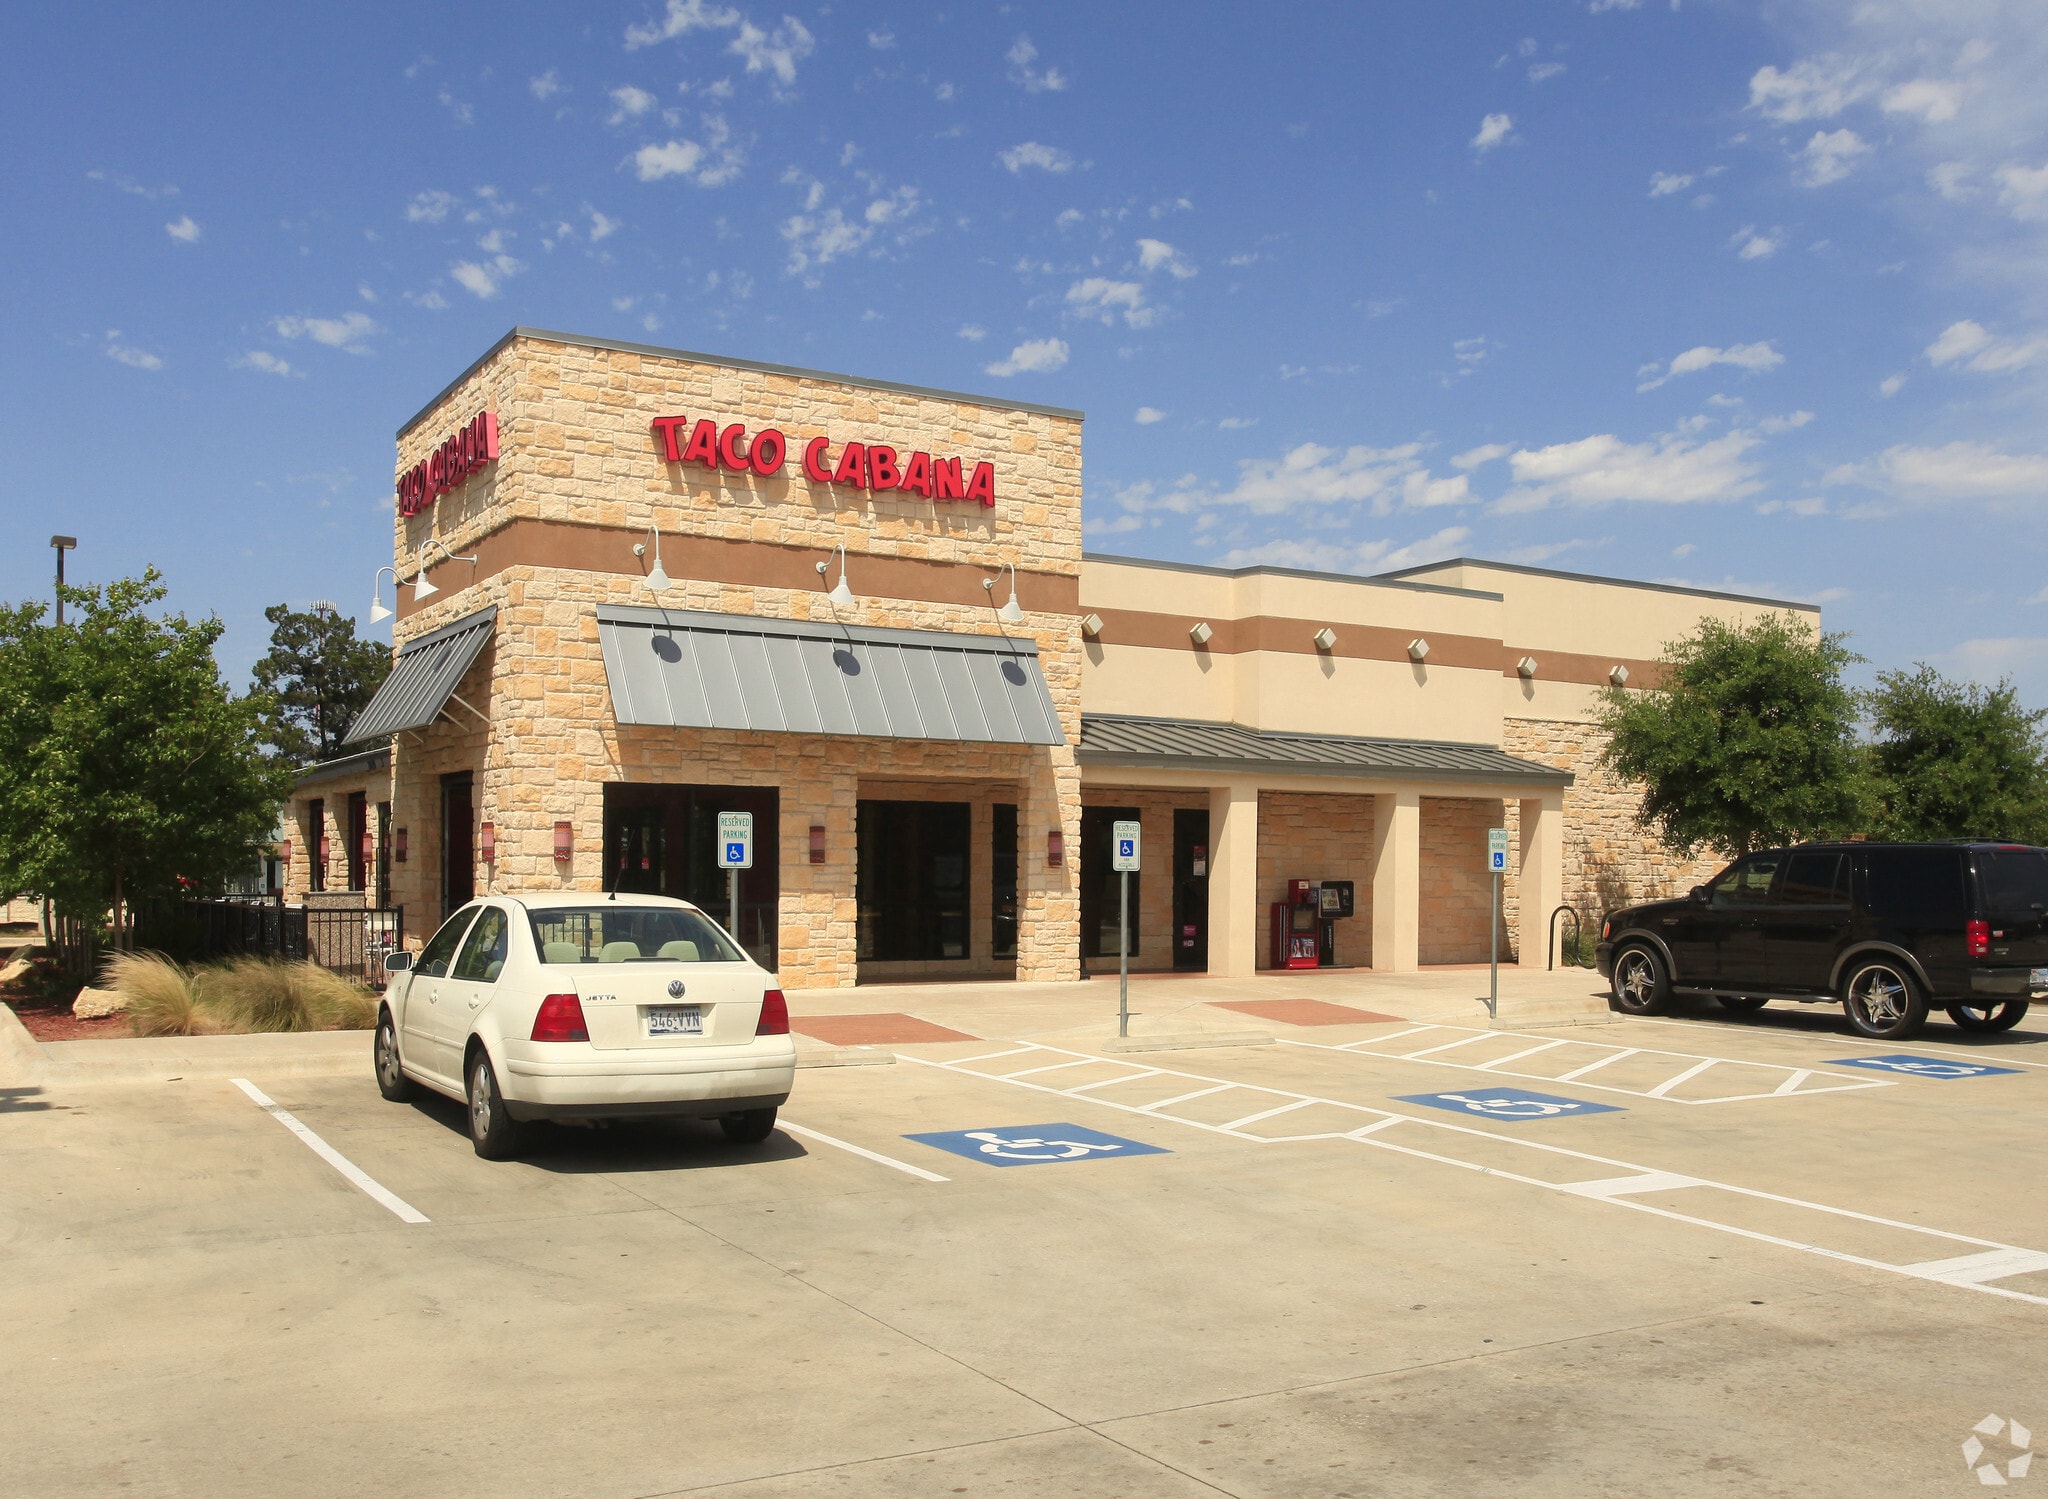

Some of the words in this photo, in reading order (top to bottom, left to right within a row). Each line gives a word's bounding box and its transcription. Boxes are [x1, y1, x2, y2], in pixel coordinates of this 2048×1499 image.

[652, 415, 786, 476] TACO
[801, 436, 995, 508] CABANA
[720, 818, 750, 826] RESERVED
[723, 830, 747, 839] PARKING
[651, 1012, 672, 1027] 546
